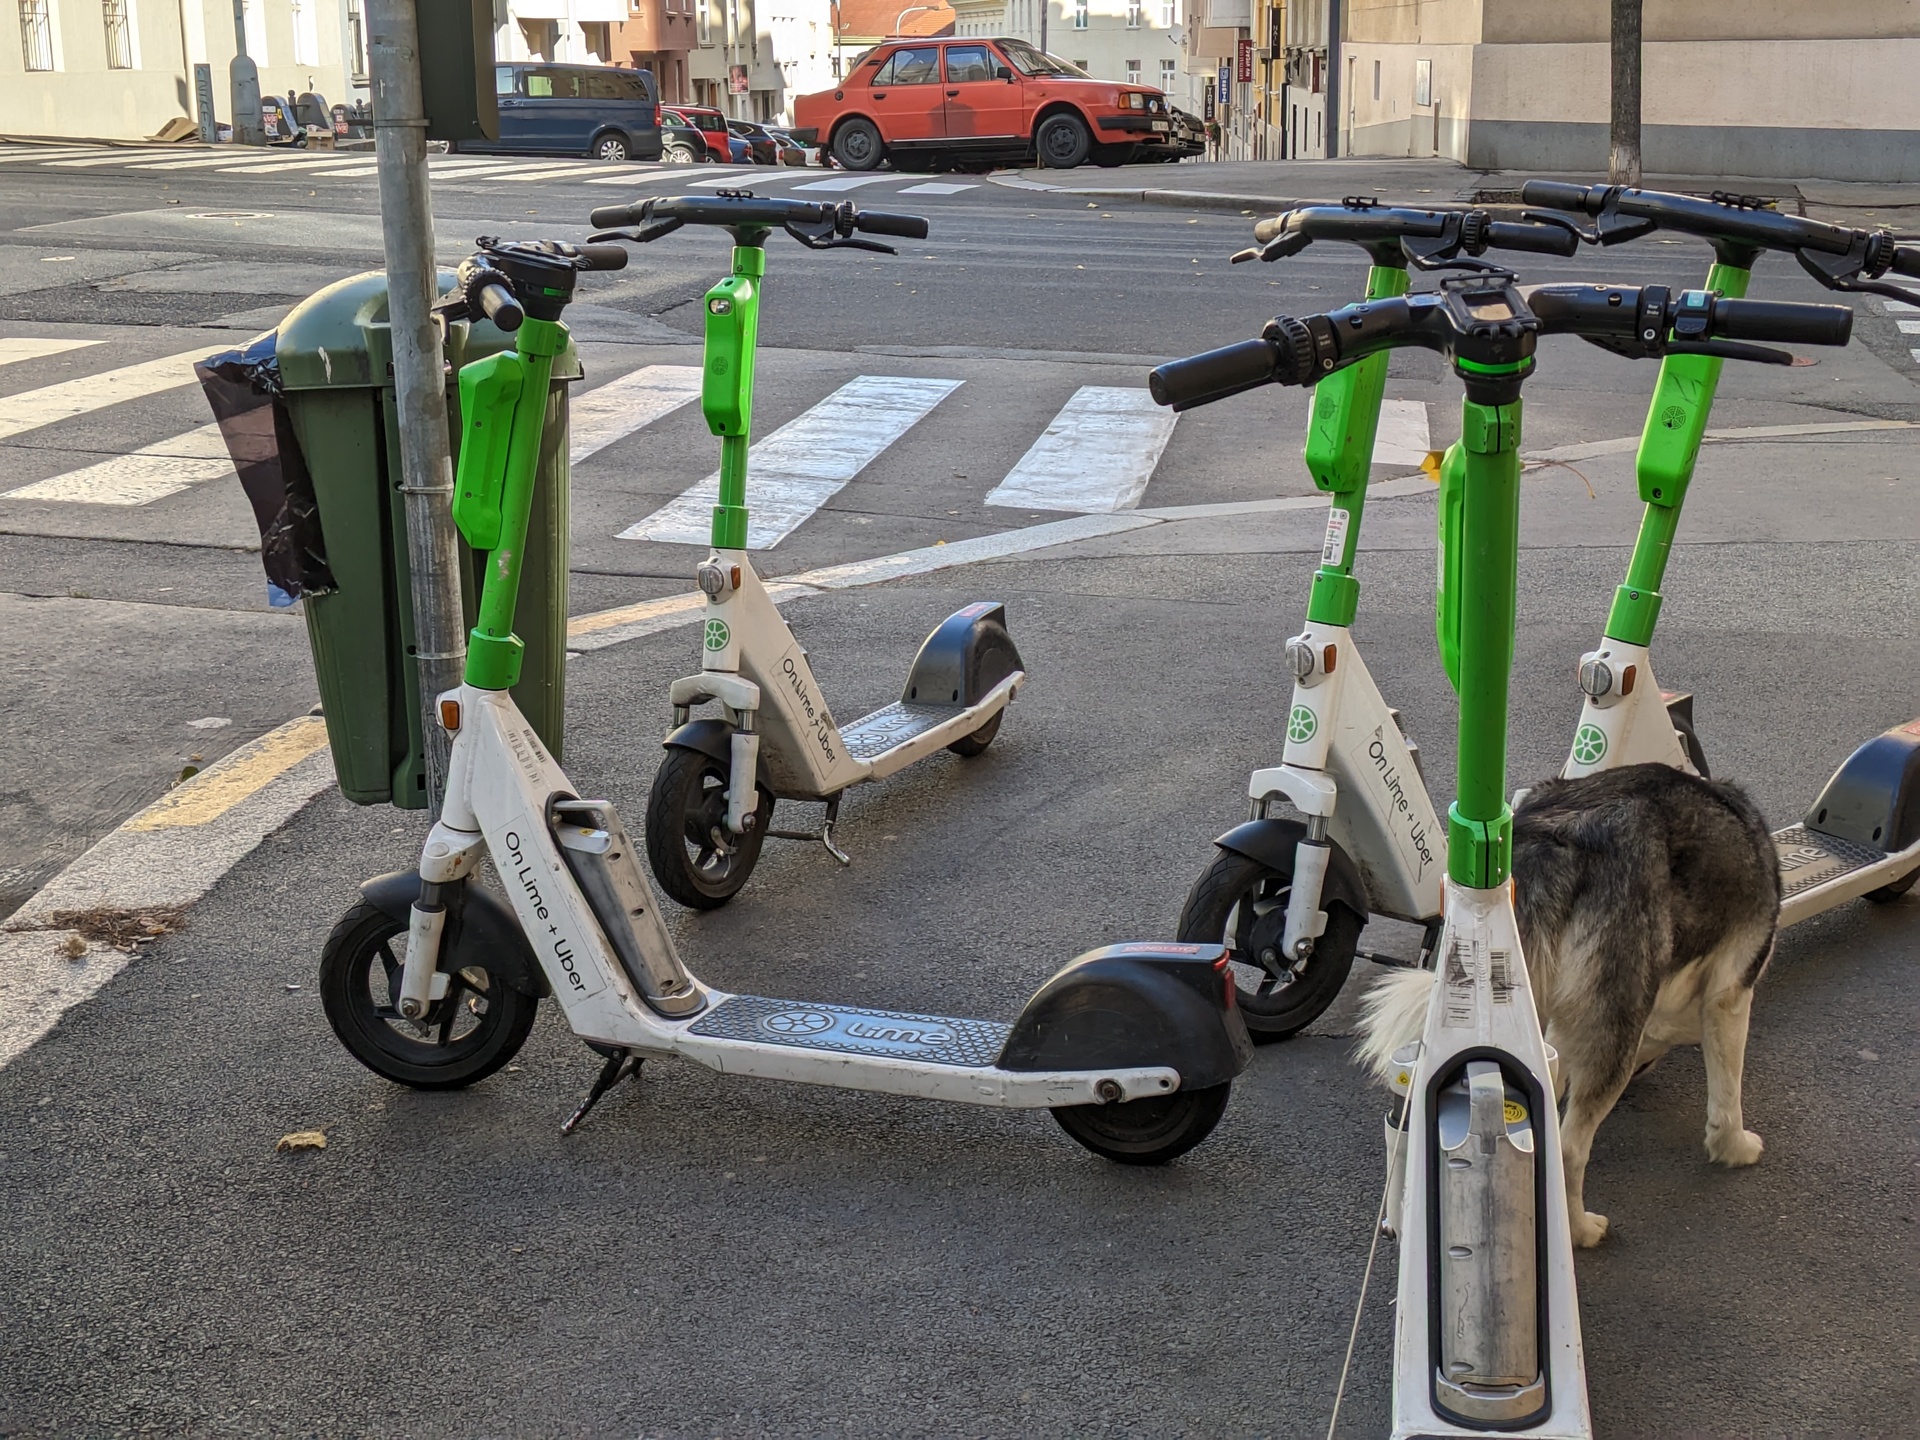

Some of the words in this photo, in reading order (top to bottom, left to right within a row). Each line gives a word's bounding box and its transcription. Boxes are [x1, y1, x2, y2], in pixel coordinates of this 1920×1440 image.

[783, 659, 797, 685] On
[818, 727, 835, 763] Uber
[1369, 741, 1387, 771] On
[1383, 767, 1408, 812] Lime
[1411, 821, 1433, 866] Uber
[506, 832, 523, 866] On
[519, 867, 549, 920] Lime
[554, 939, 586, 991] Uber
[847, 1022, 951, 1045] Lime
